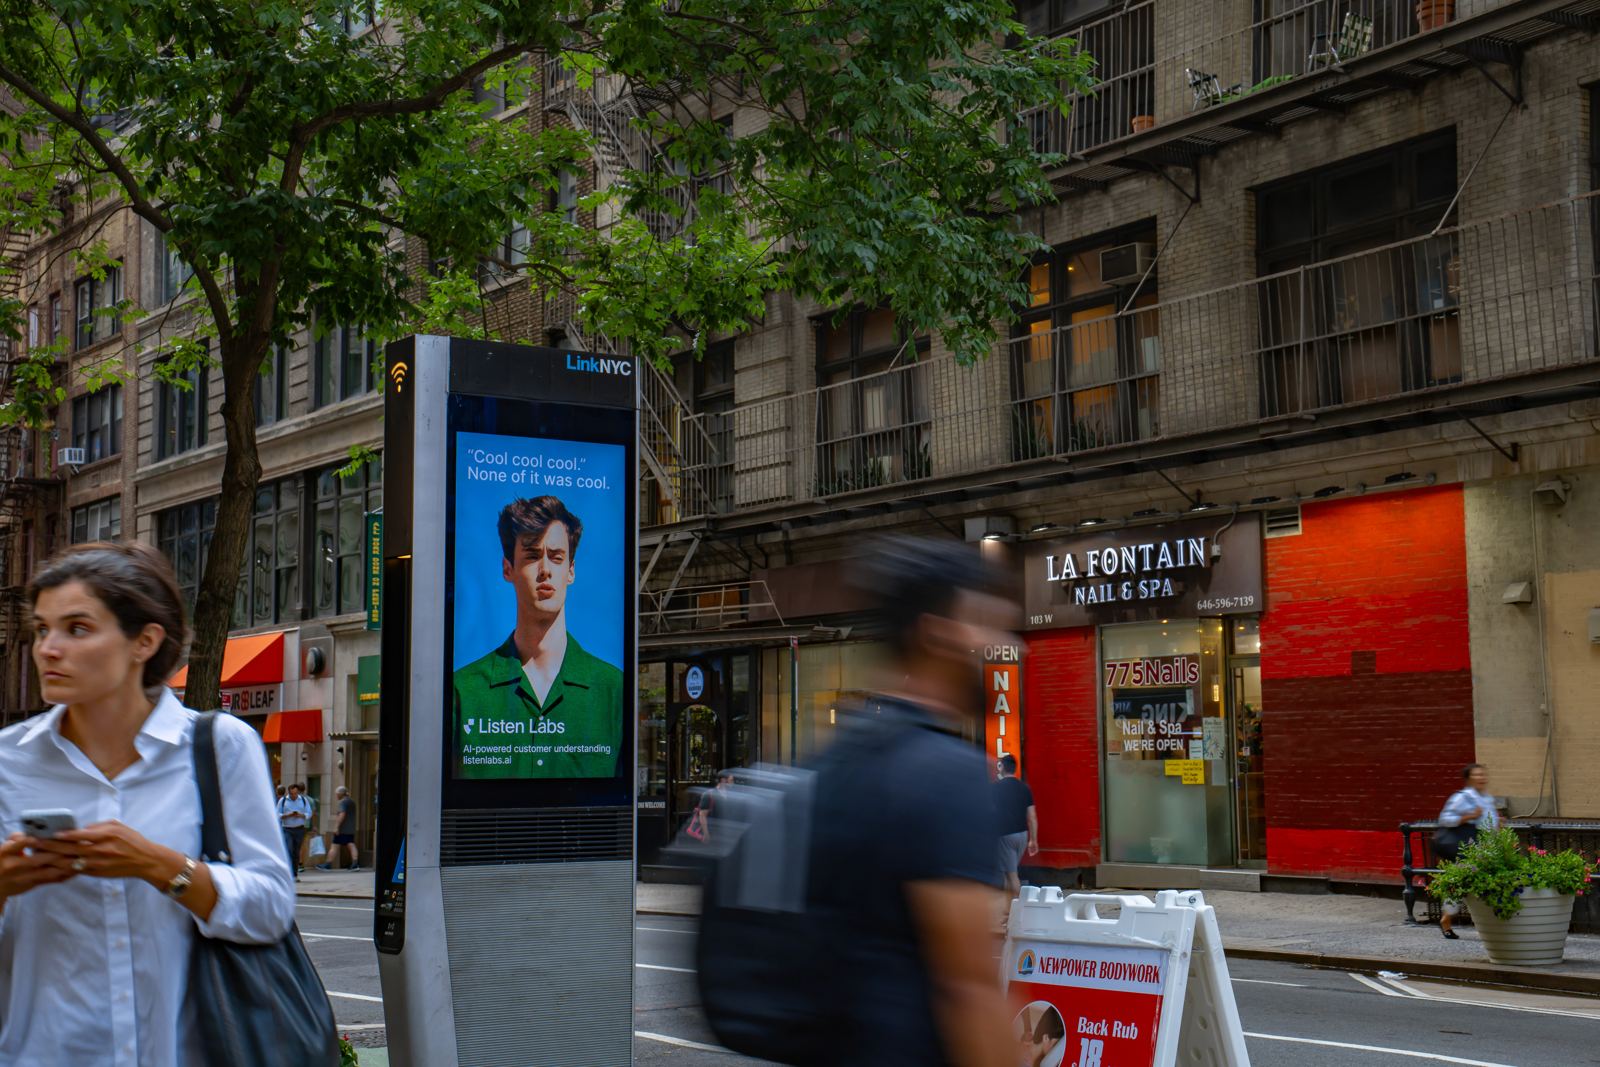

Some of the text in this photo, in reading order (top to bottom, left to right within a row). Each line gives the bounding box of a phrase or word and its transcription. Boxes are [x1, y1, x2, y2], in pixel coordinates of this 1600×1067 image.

[566, 354, 631, 376] LinkNYC
[512, 454, 543, 468] cool
[467, 466, 611, 490] None of it was cool.
[1046, 536, 1205, 581] LA FONTAIN
[1074, 578, 1174, 606] NAIL & SPA
[1197, 595, 1254, 611] 646-596-7139
[1029, 614, 1053, 626] 103 W
[983, 645, 1019, 662] OPEN
[1105, 657, 1199, 687] 775Nails
[250, 690, 274, 708] LEAF
[478, 718, 566, 734] Listen Labs
[1122, 719, 1183, 738] Nail & Spa
[463, 743, 611, 755] AI-powered customer understanding
[1124, 738, 1184, 752] WE'RE OPEN
[463, 755, 513, 766] listenlabs.ai
[1039, 956, 1161, 984] NEWPOWER BODYWORK
[1077, 1016, 1139, 1040] Back Rub
